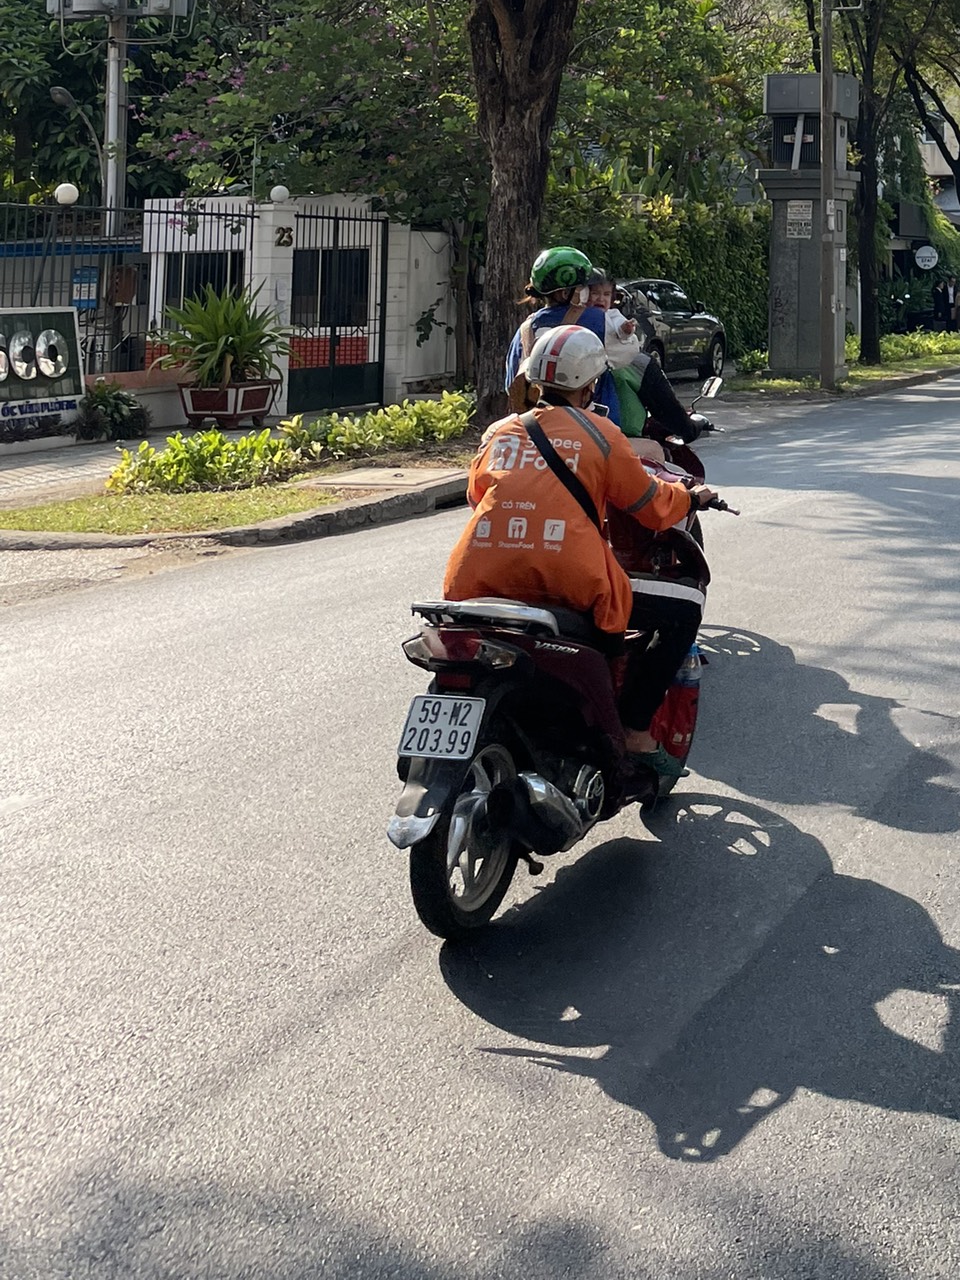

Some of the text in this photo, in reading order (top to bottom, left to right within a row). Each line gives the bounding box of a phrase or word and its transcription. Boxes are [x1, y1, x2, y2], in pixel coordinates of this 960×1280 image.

[274, 226, 294, 247] 23
[525, 435, 582, 451] Spee
[519, 450, 579, 474] Fod
[403, 727, 472, 754] 203.99
